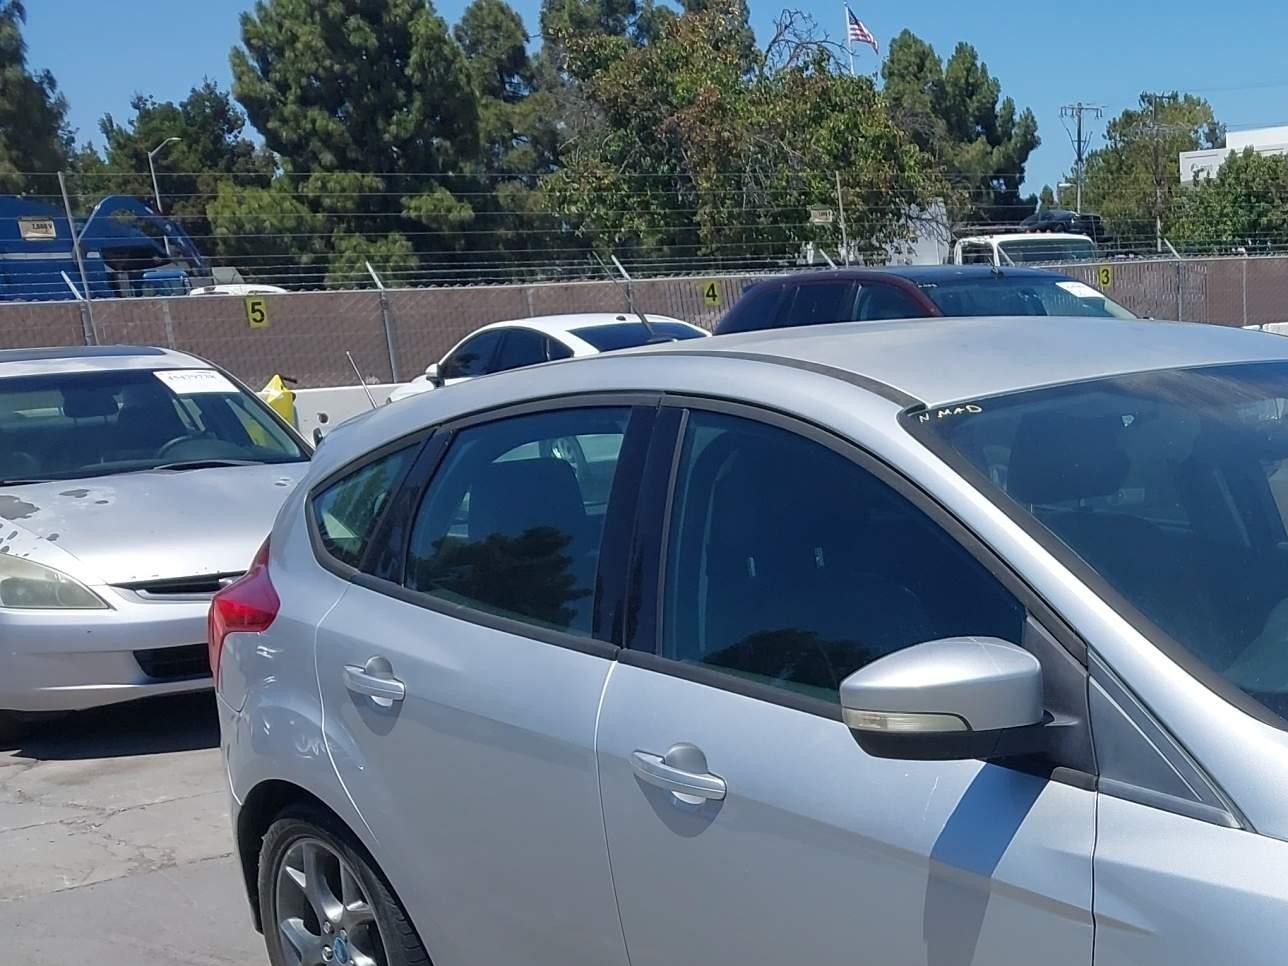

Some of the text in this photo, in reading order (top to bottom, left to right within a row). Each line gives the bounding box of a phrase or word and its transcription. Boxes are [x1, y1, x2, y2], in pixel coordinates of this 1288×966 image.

[1101, 268, 1110, 286] 3
[705, 283, 718, 302] 4
[250, 301, 265, 323] 5
